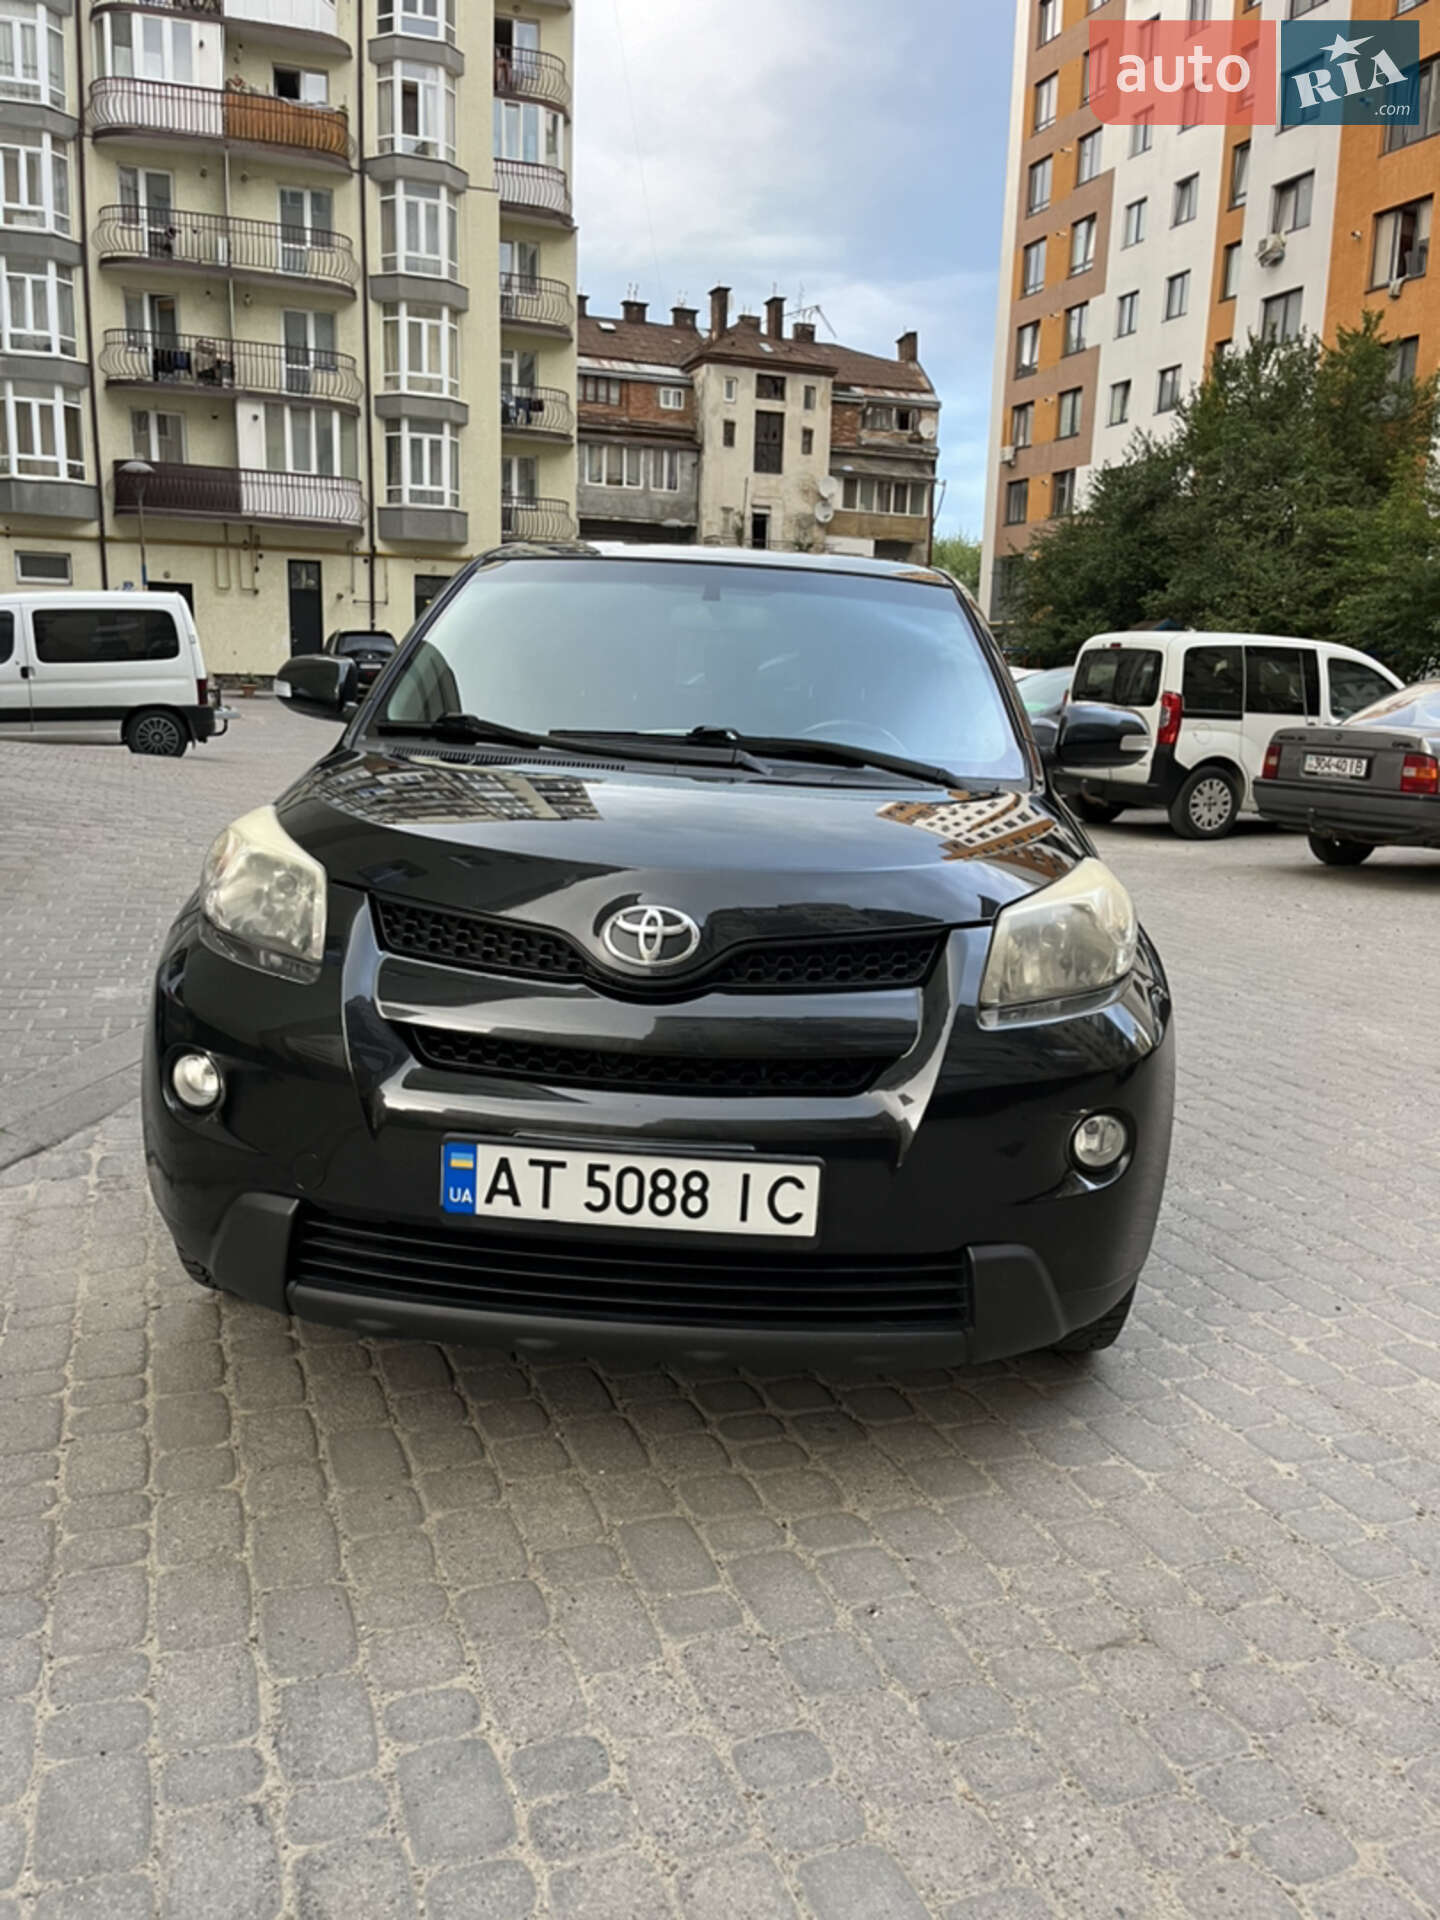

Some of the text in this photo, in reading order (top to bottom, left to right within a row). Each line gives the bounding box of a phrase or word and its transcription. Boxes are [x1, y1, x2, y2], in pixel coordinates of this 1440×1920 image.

[448, 1186, 473, 1204] UA
[484, 1156, 806, 1226] AT 5088 IC
